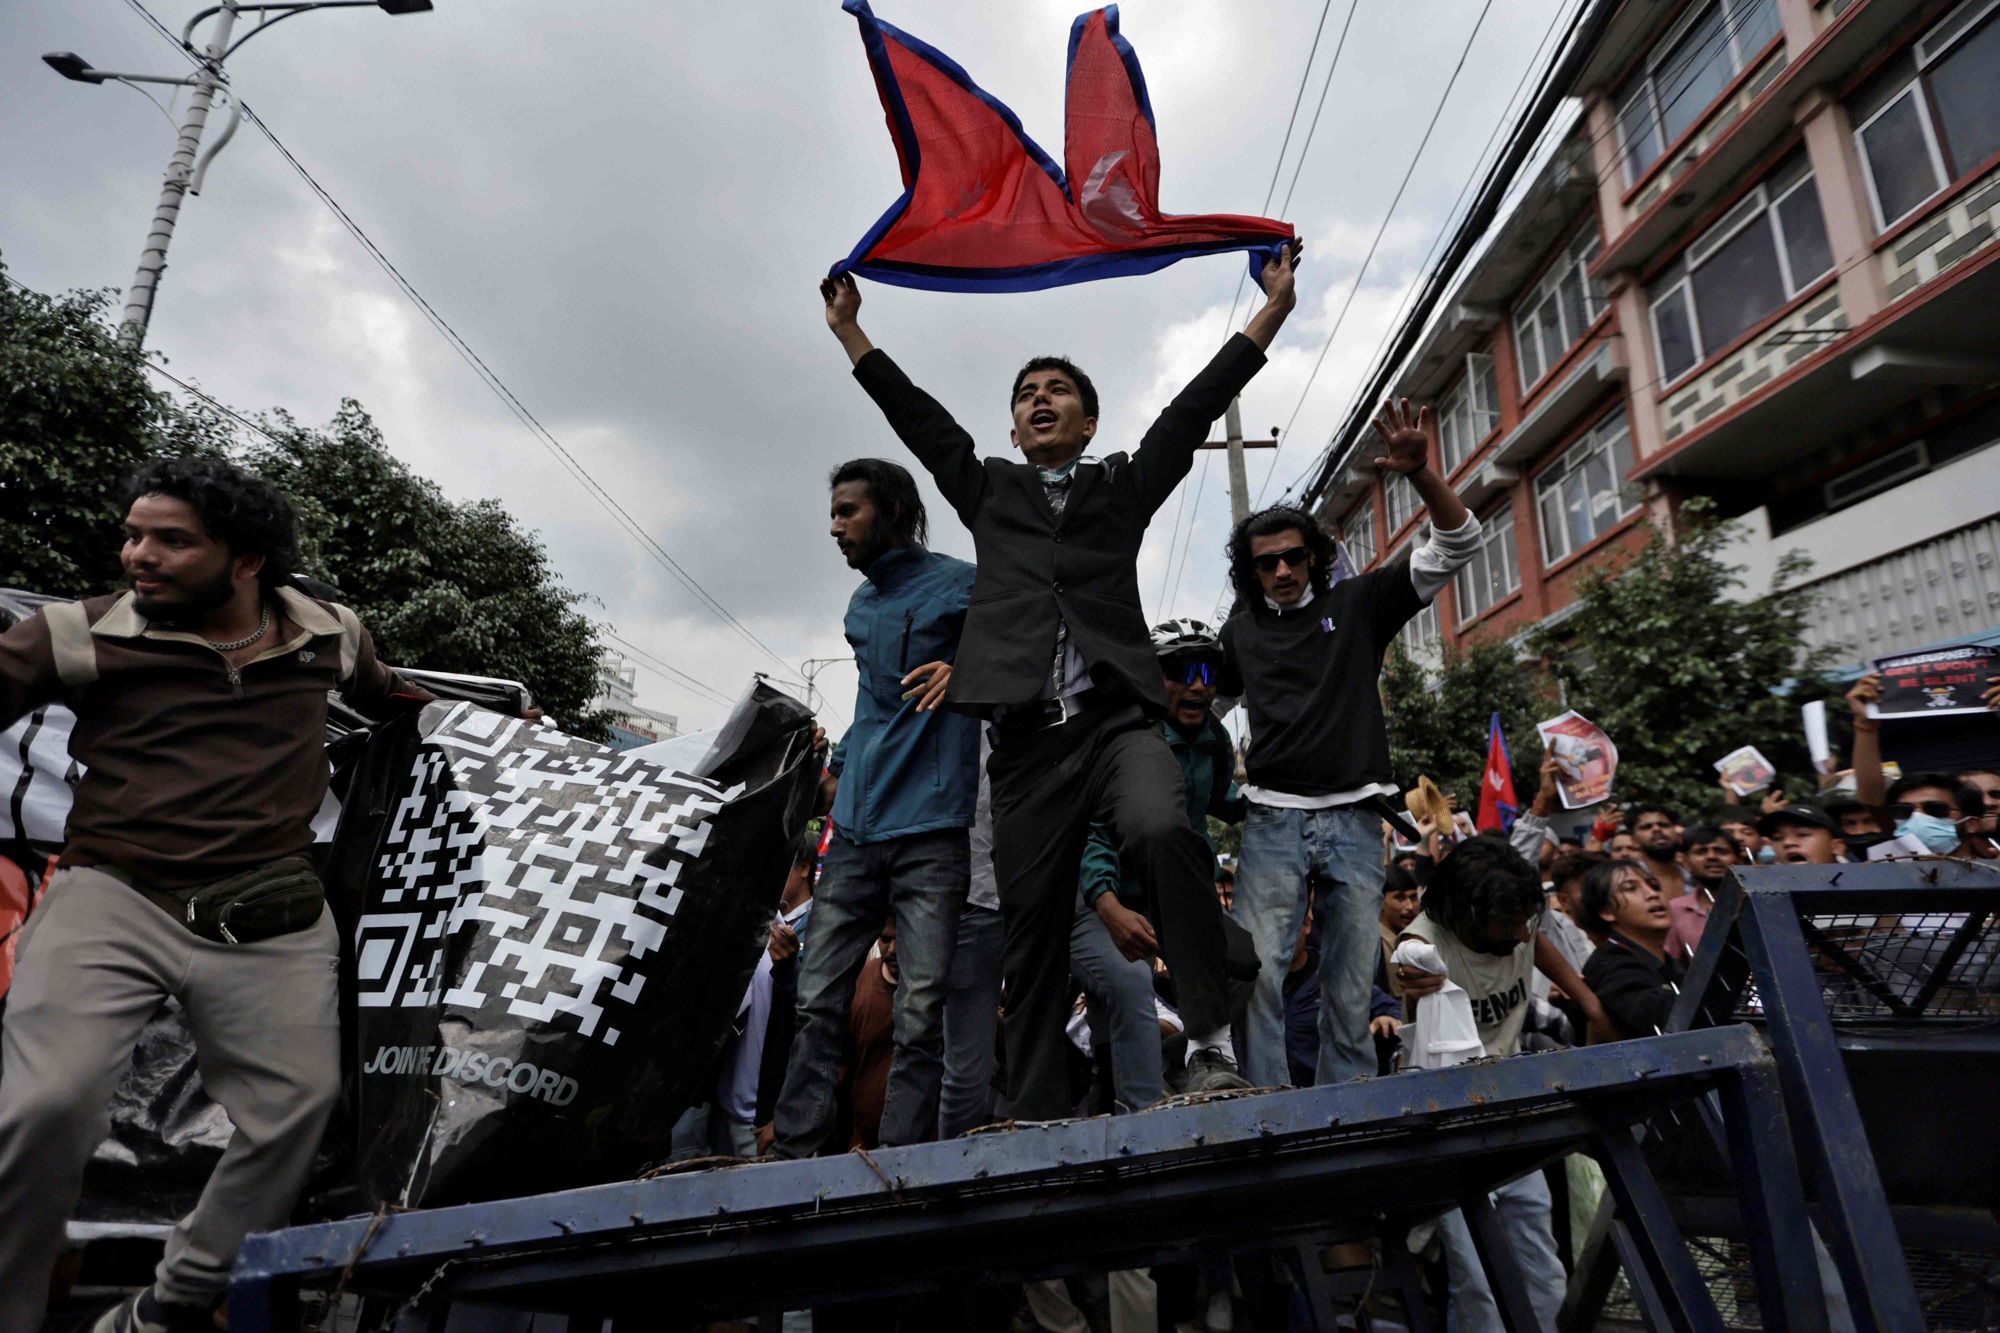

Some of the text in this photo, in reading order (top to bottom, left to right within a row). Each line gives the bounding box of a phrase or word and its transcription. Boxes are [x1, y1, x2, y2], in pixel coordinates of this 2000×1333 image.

[1883, 665, 1917, 676] GEN
[1920, 663, 1930, 673] Z
[1899, 673, 1977, 687] BE SILENT
[364, 1046, 419, 1074] JOIN
[432, 1047, 579, 1107] DISCORD
